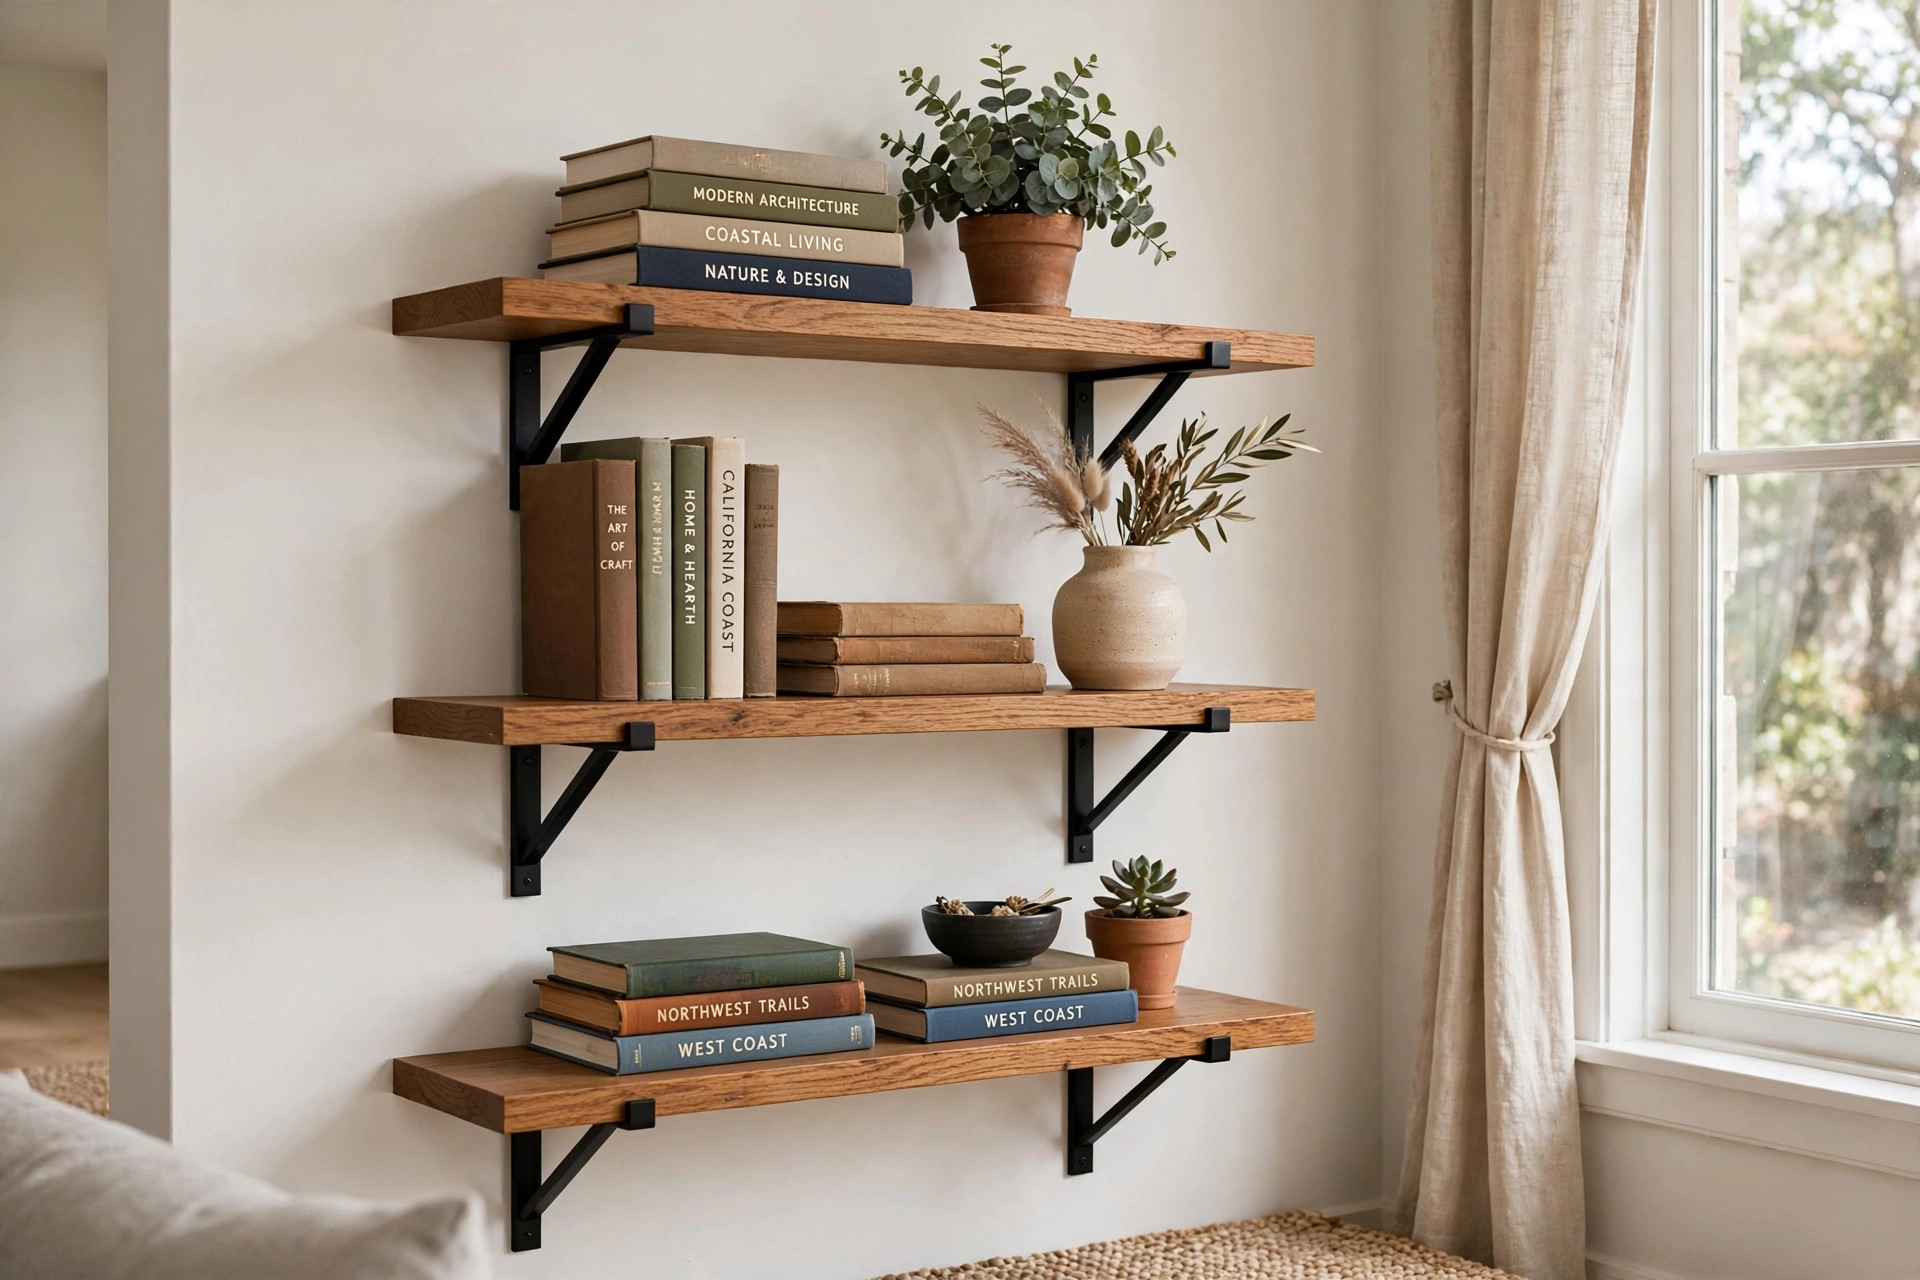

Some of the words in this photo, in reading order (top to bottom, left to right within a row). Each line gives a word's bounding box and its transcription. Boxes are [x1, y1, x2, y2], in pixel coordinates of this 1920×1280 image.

[693, 186, 754, 205] MODERN
[759, 193, 859, 216] ARCHITECTURE
[705, 225, 782, 248] COASTAL
[789, 233, 844, 252] LIVING
[705, 263, 770, 283] NATURE
[775, 269, 787, 285] &
[793, 270, 850, 290] DESIGN
[607, 504, 628, 515] THE
[684, 489, 696, 537] HOME
[607, 522, 628, 533] ART
[721, 469, 735, 585] CALIFORNIA
[610, 541, 625, 552] OF
[684, 543, 696, 554] &
[600, 559, 634, 570] CRAFT
[684, 560, 696, 625] HEARTH
[721, 591, 735, 653] COAST
[953, 977, 1044, 999] NORTHWEST
[1049, 972, 1098, 990] TRAILS
[657, 1000, 752, 1023] NORTHWEST
[758, 995, 810, 1013] TRAILS
[984, 1010, 1027, 1029] WEST
[1033, 1005, 1084, 1024] COAST
[677, 1039, 725, 1058] WEST
[732, 1033, 788, 1053] COAST
